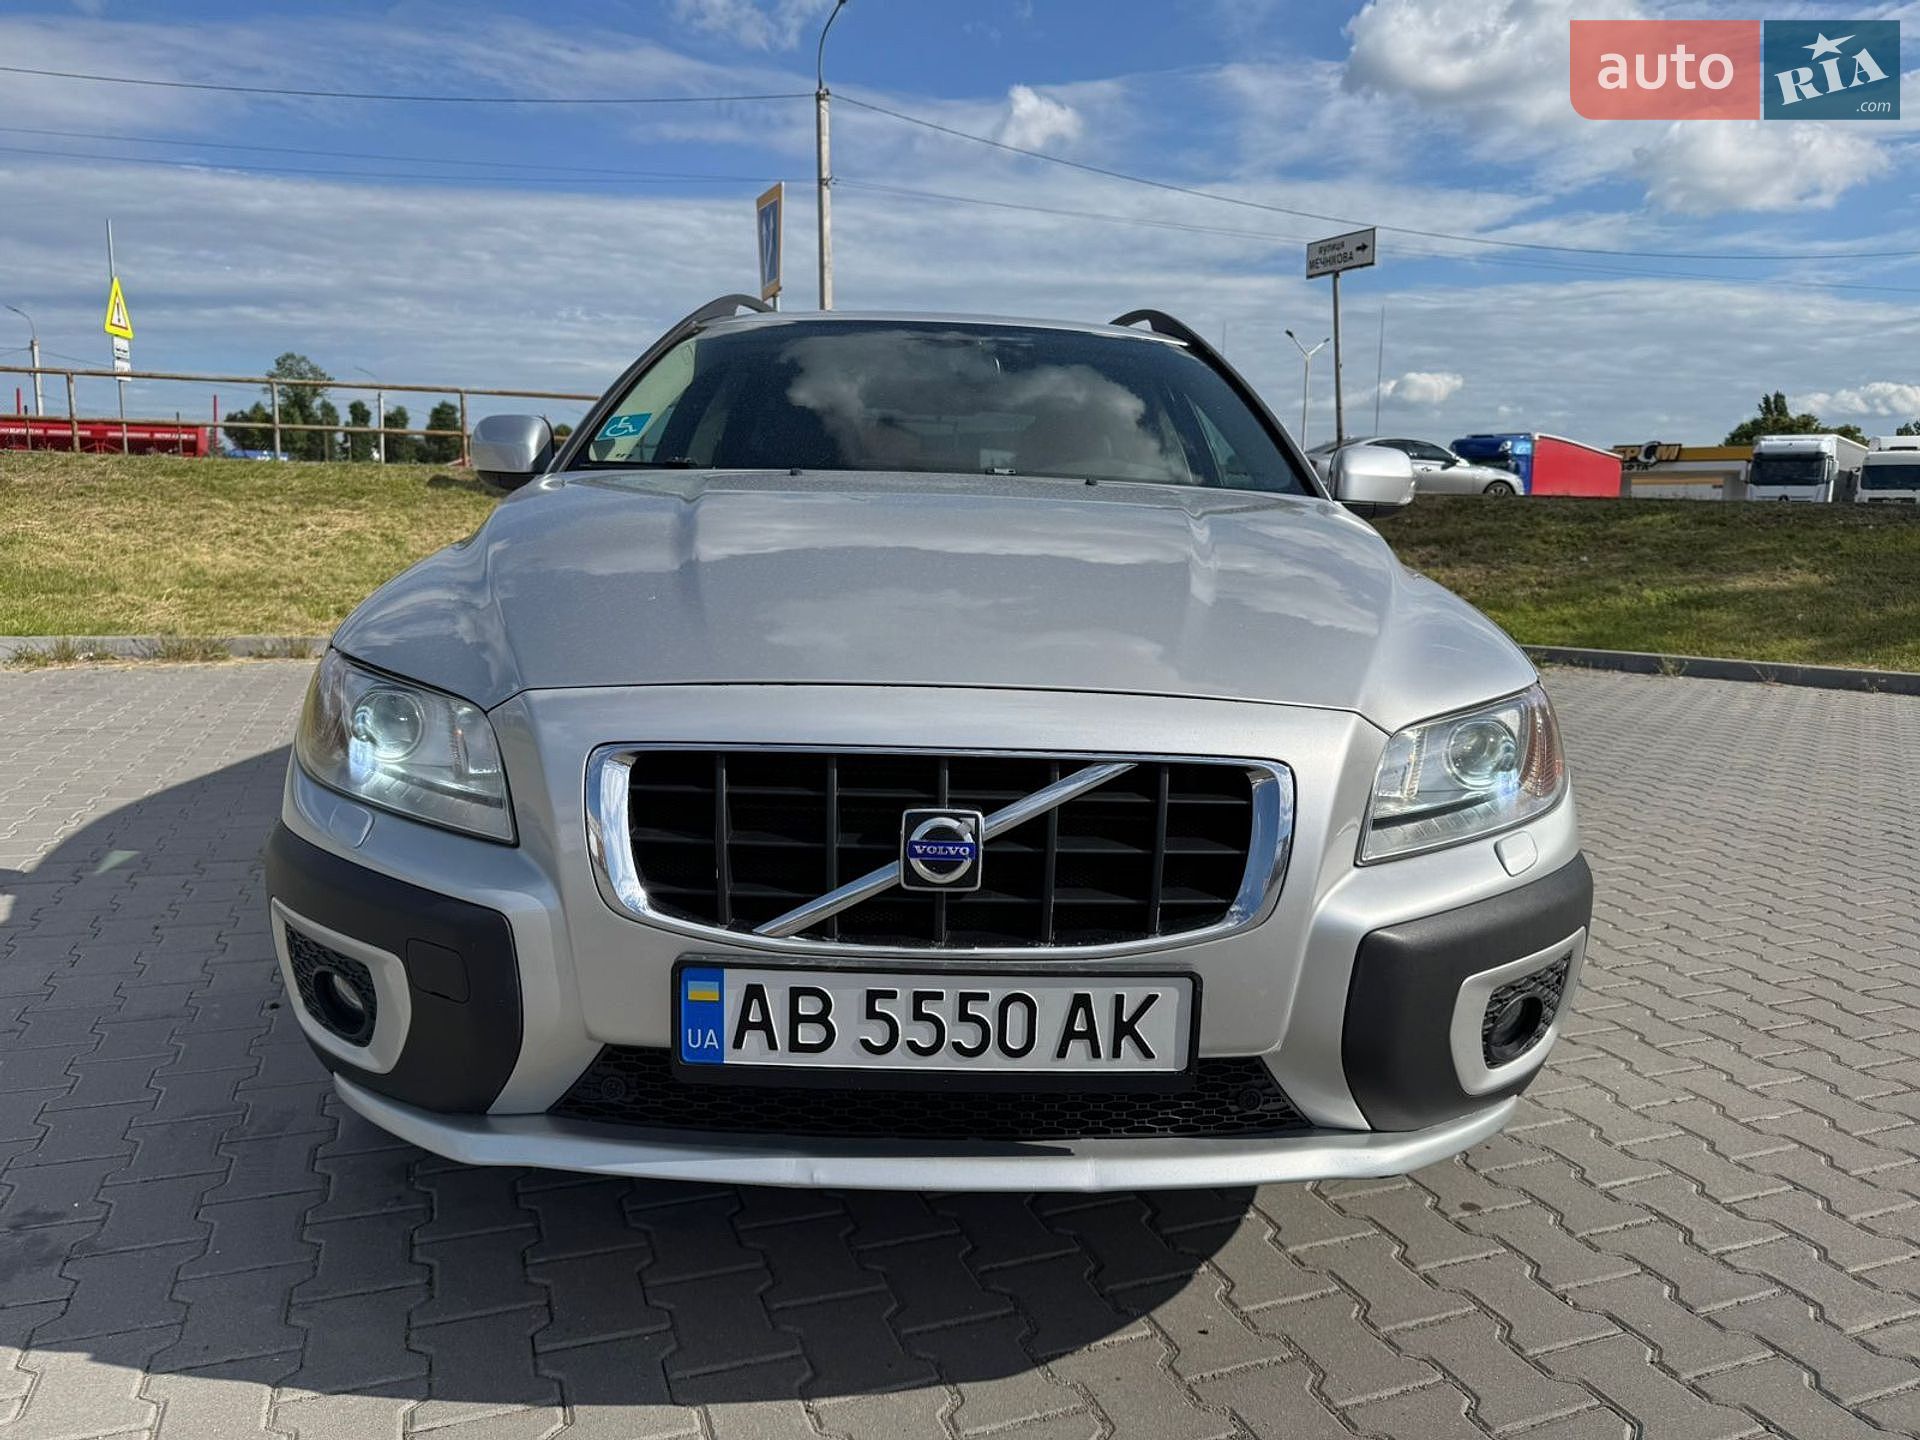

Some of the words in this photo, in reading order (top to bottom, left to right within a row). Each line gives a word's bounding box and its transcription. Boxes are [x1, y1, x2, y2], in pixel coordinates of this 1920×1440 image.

[913, 844, 970, 856] VOLVO
[732, 983, 837, 1054] AB
[859, 988, 1038, 1059] 5550
[1057, 993, 1160, 1060] AK
[687, 1028, 719, 1050] UA
